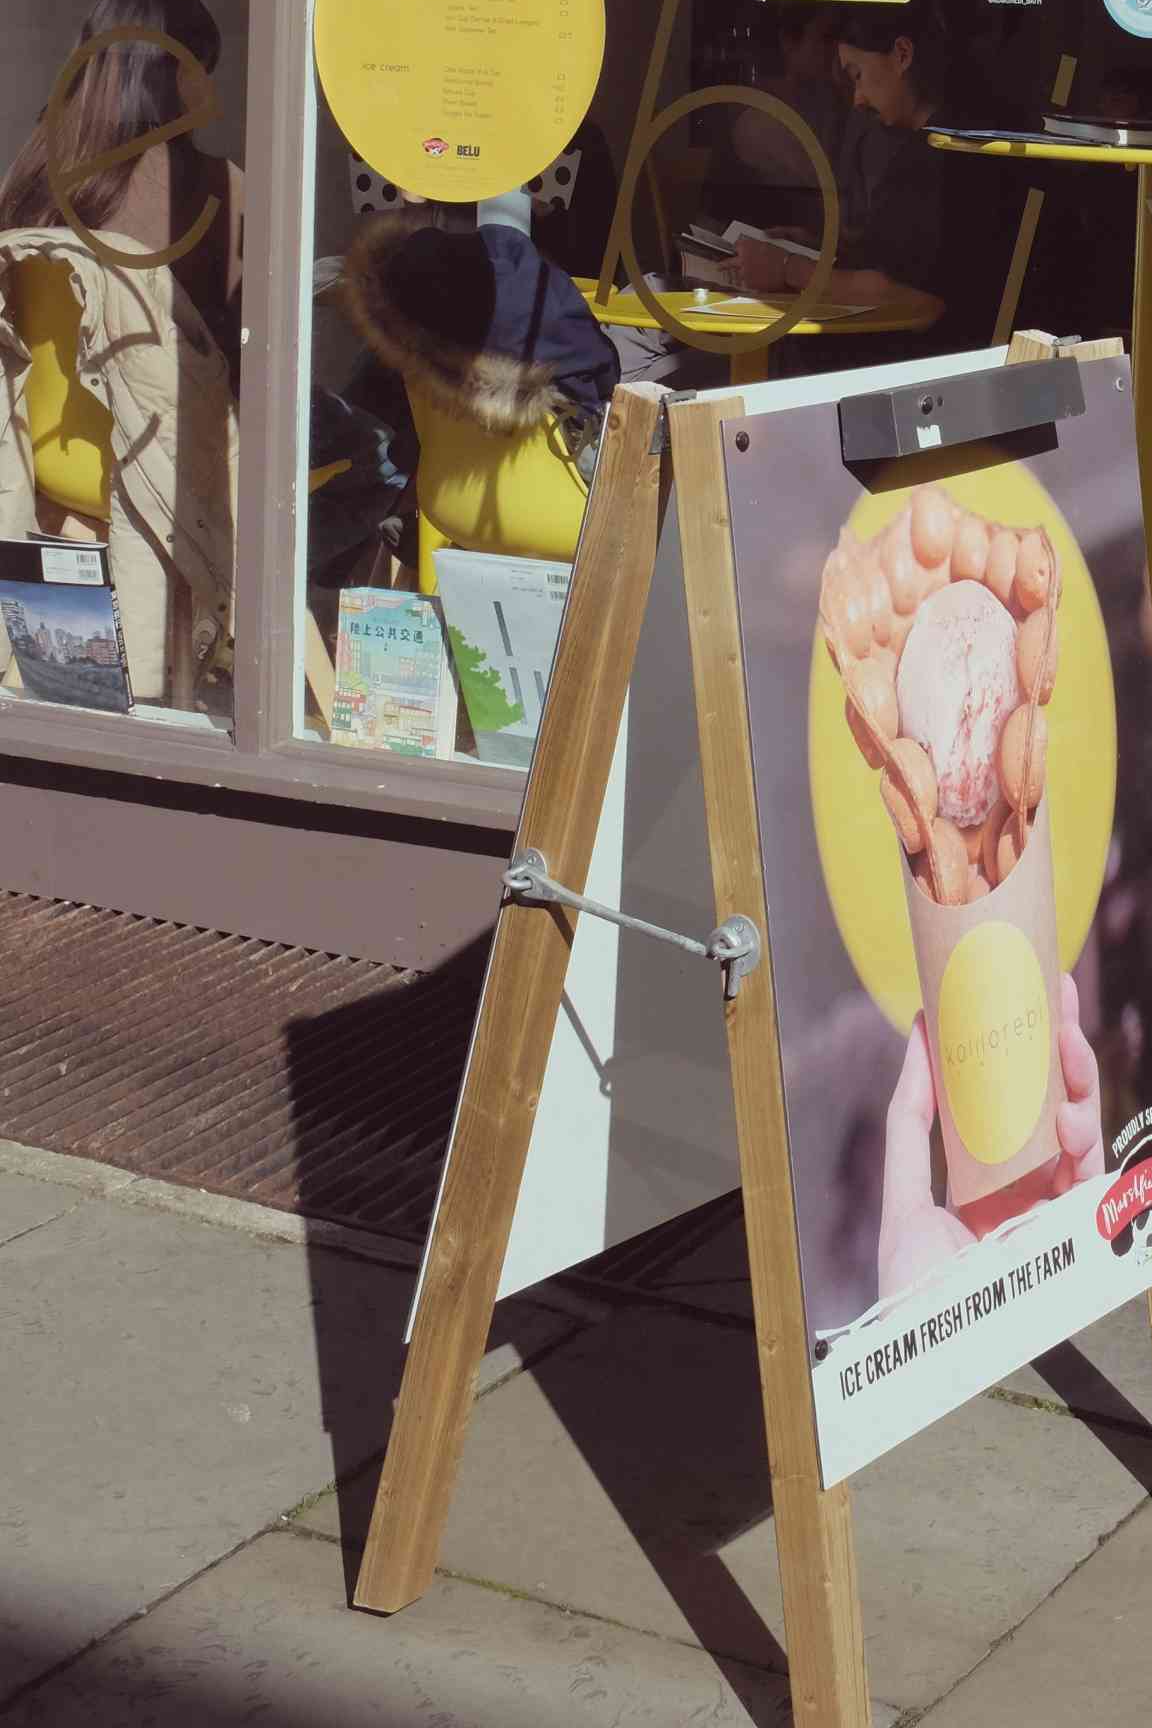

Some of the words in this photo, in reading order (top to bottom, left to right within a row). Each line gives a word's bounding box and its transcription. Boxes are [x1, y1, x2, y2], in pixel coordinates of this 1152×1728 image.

[1111, 1111, 1145, 1159] PROUDLY
[839, 1361, 863, 1400] ICE
[865, 1329, 918, 1385] CREAM
[920, 1302, 963, 1353] FRESH
[965, 1277, 1007, 1325] FROM
[1008, 1261, 1034, 1300] THE
[1036, 1238, 1076, 1284] FARM
